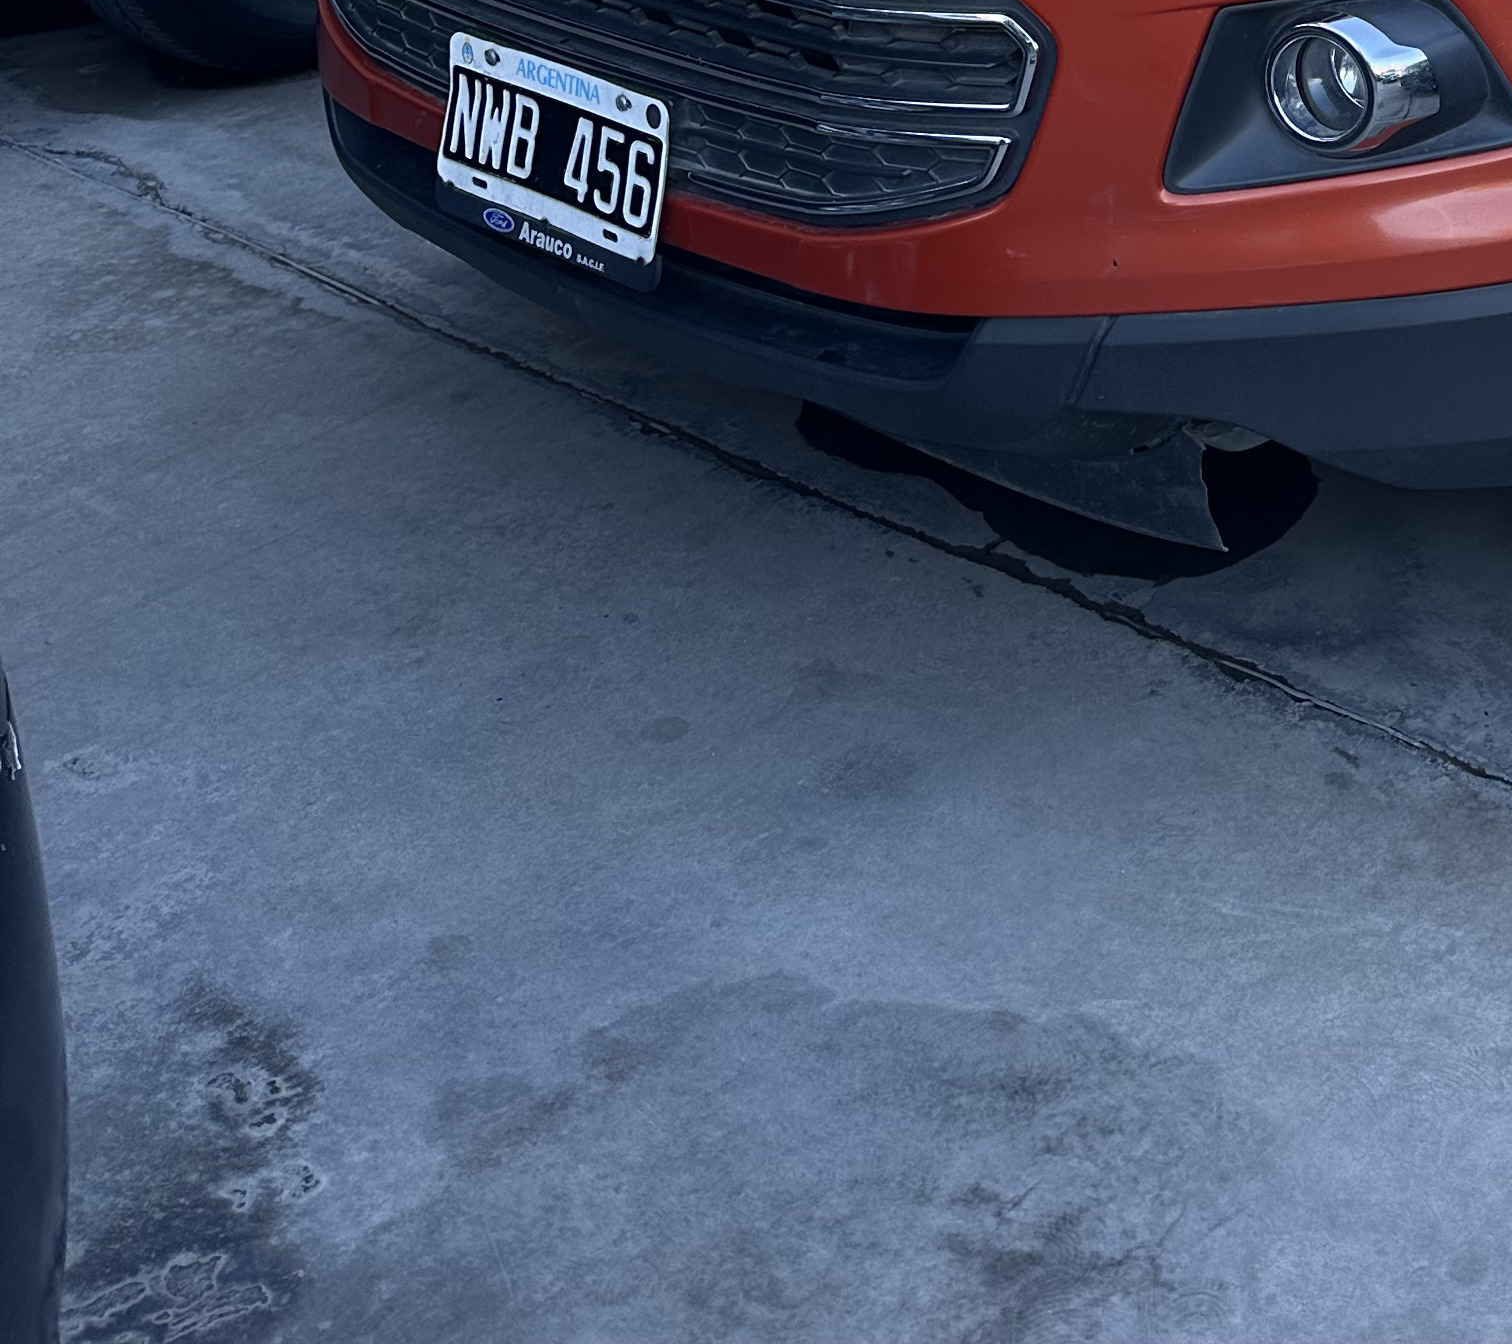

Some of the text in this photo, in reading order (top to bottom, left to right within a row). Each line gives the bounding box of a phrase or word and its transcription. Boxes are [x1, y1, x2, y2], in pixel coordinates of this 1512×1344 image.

[515, 57, 601, 106] ARGENTINA
[449, 73, 656, 229] NWB 456
[518, 221, 573, 260] Arauco
